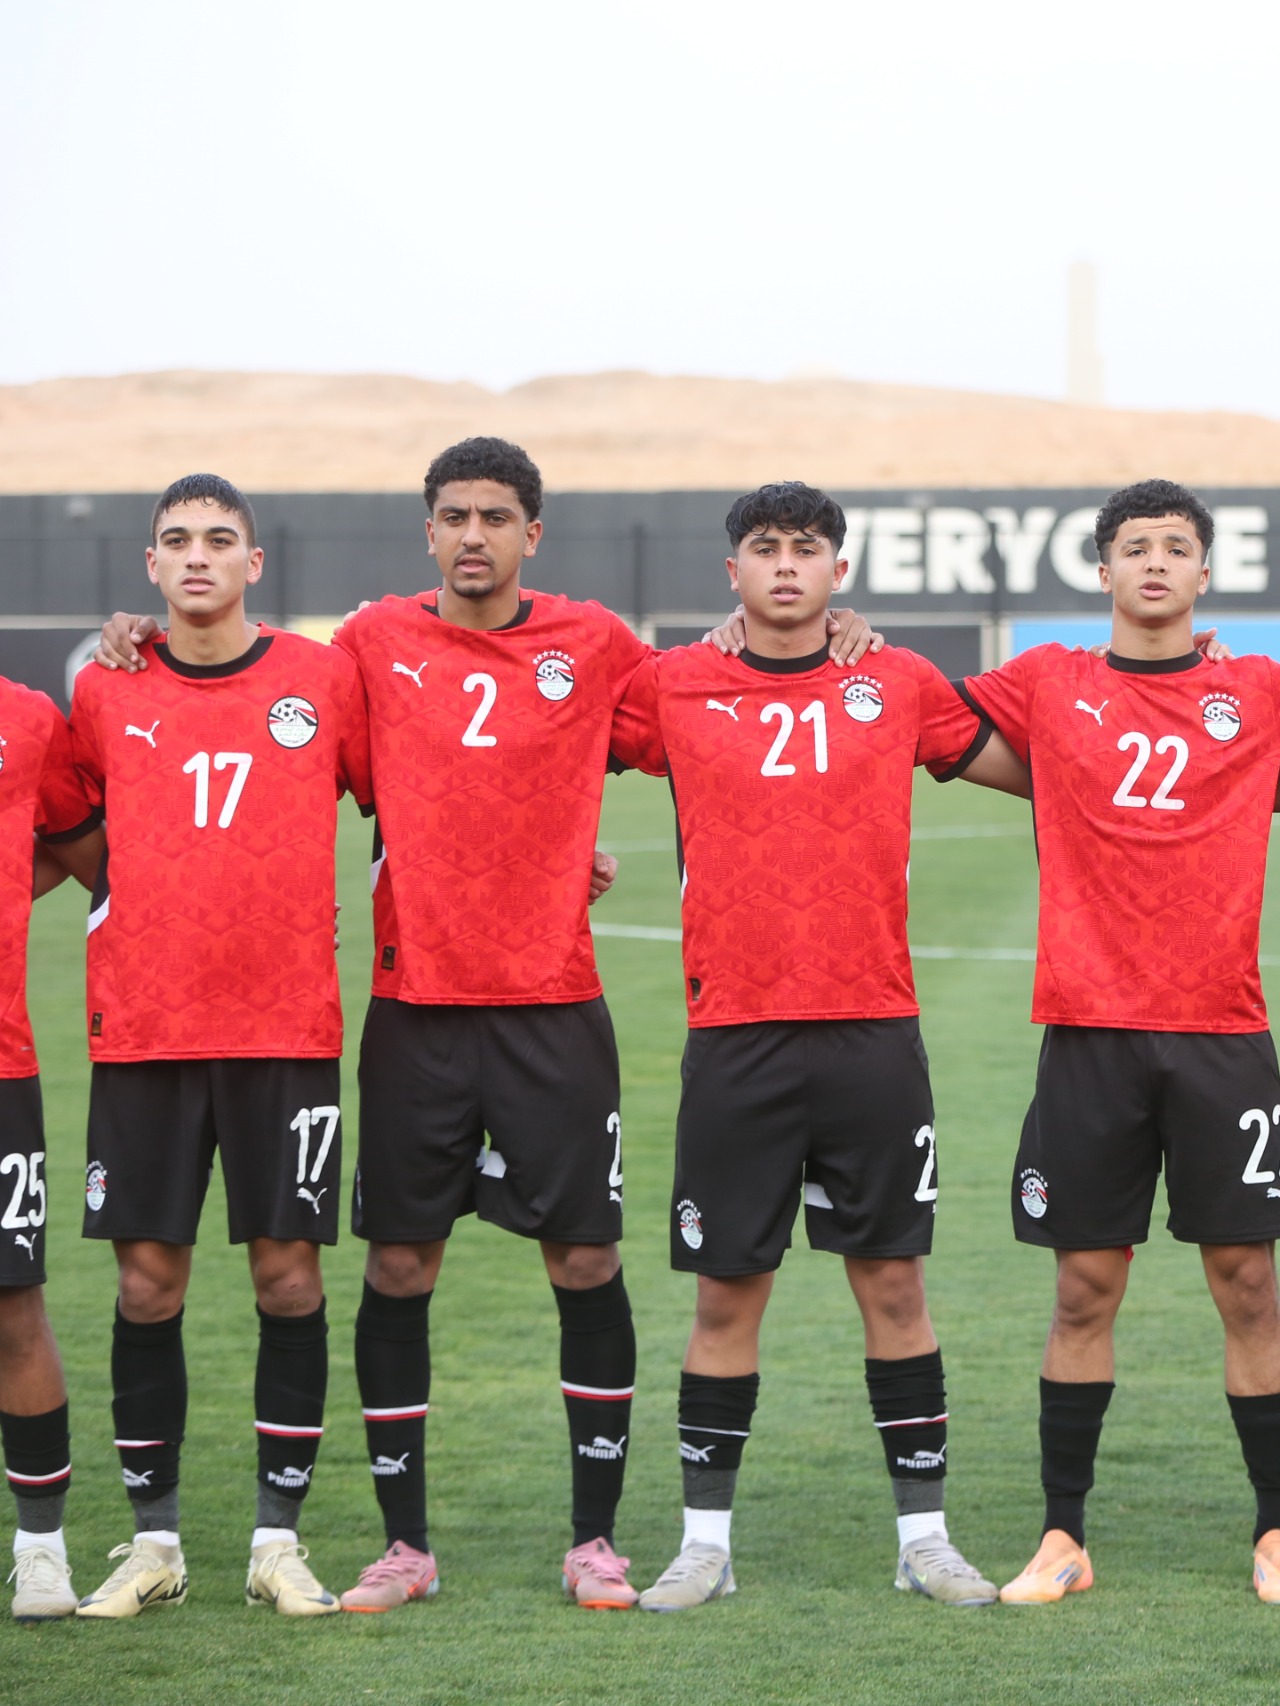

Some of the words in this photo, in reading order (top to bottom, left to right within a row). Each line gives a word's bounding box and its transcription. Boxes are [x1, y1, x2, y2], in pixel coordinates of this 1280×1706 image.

[461, 672, 498, 747] 2
[759, 700, 828, 777] 21
[182, 751, 253, 829] 17
[1112, 731, 1189, 810] 22
[290, 1105, 340, 1184] 17
[0, 1151, 46, 1229] 25
[267, 1470, 306, 1488] PUMA
[577, 1443, 618, 1460] PUMA
[897, 1456, 940, 1469] PUMA
